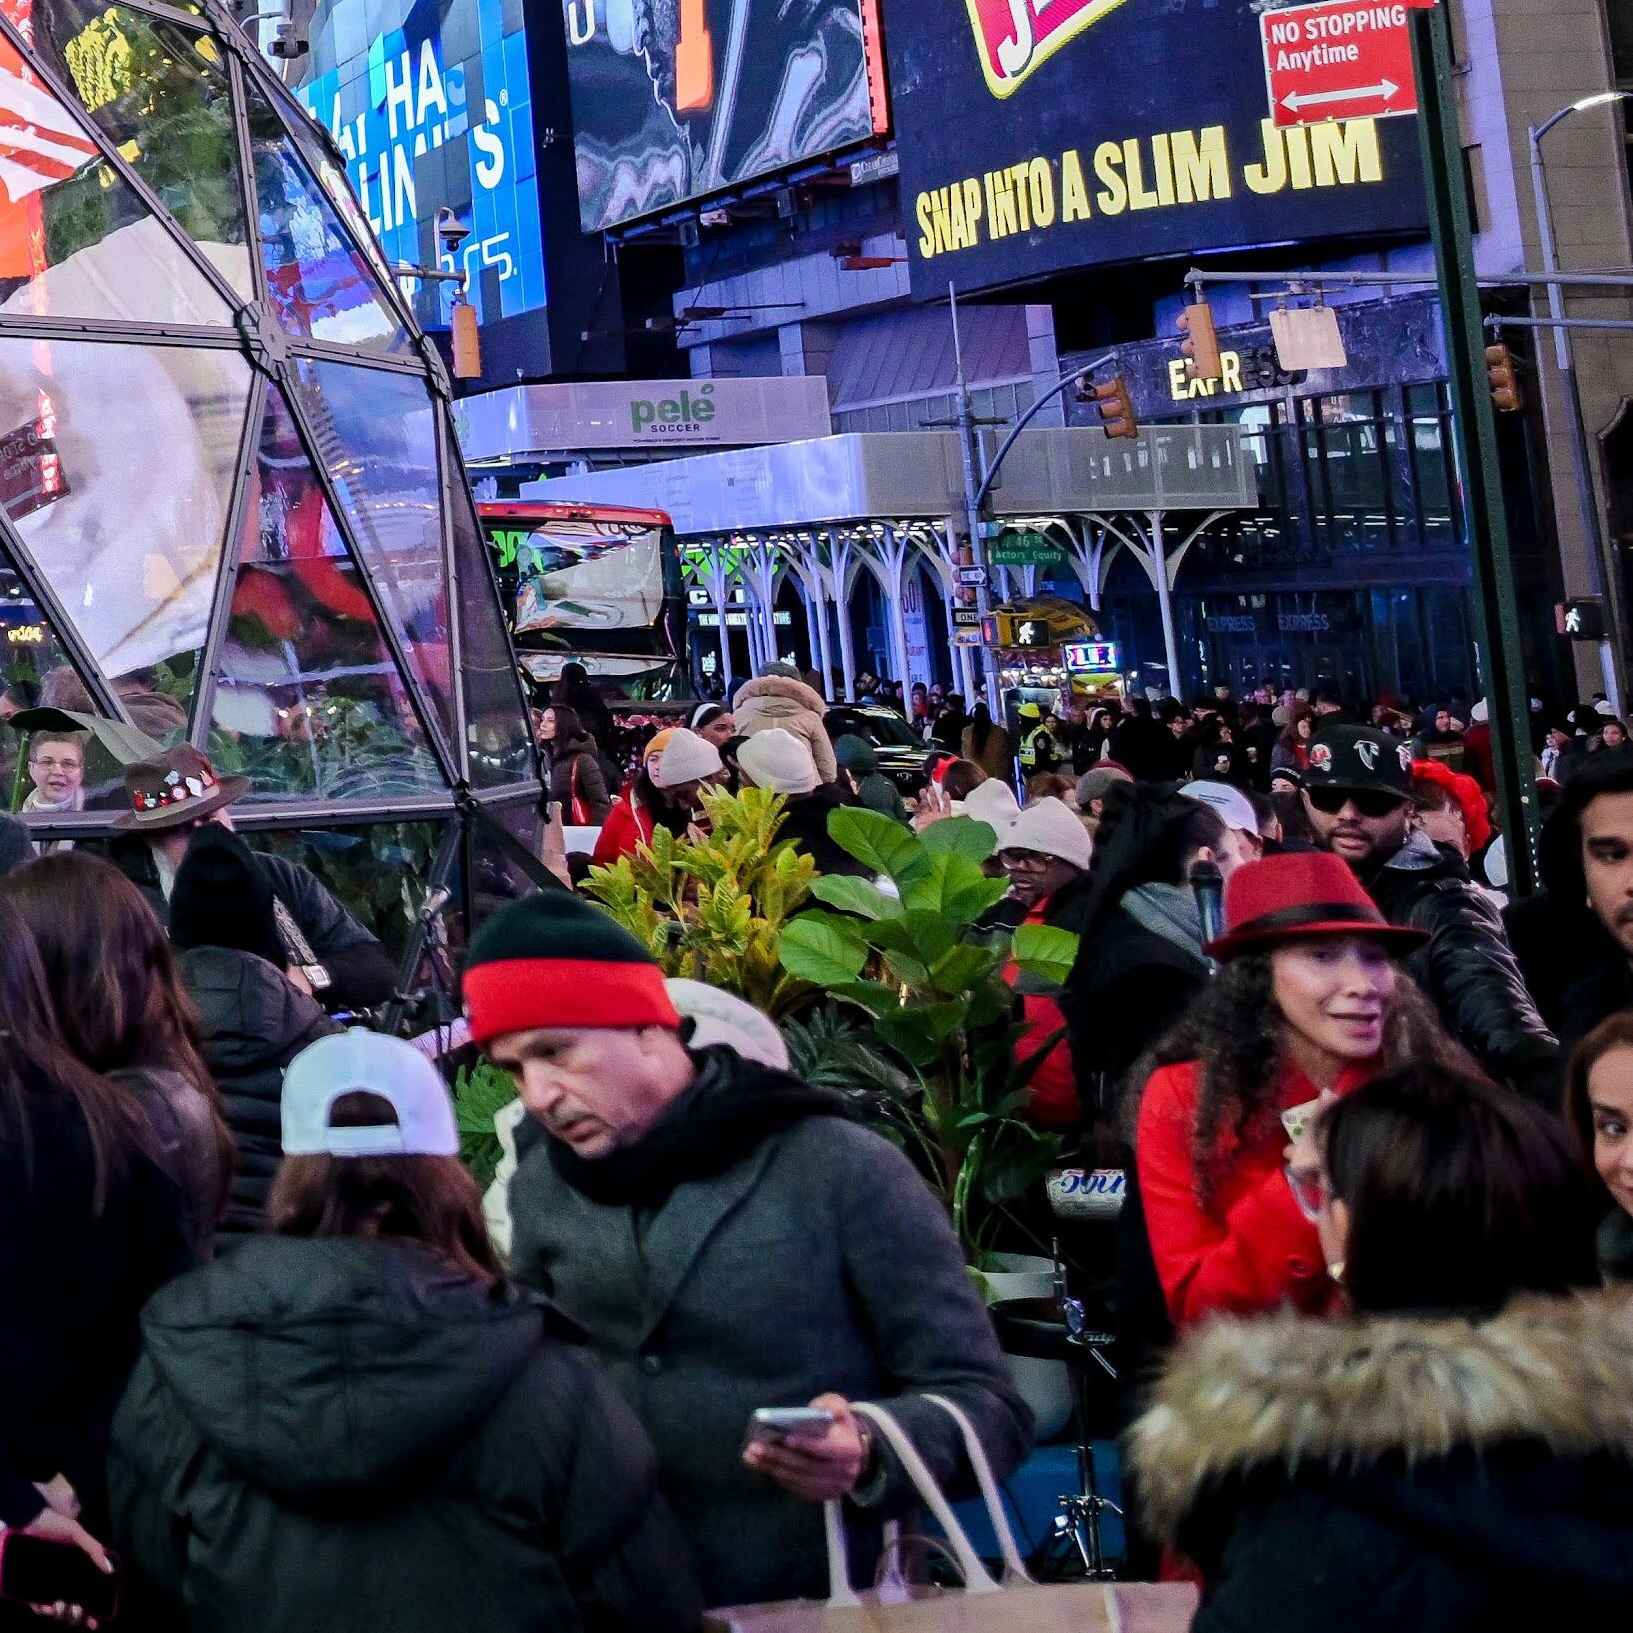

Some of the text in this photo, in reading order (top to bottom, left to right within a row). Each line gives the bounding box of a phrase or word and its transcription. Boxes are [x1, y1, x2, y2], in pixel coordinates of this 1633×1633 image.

[1271, 4, 1406, 43] NO STOPPING
[1276, 42, 1359, 73] Anytime
[916, 115, 1383, 260] SNAP INTO A SLIM JIM
[630, 383, 716, 434] pelé
[651, 423, 701, 434] SOCCER
[1277, 614, 1330, 631] EXPRESS
